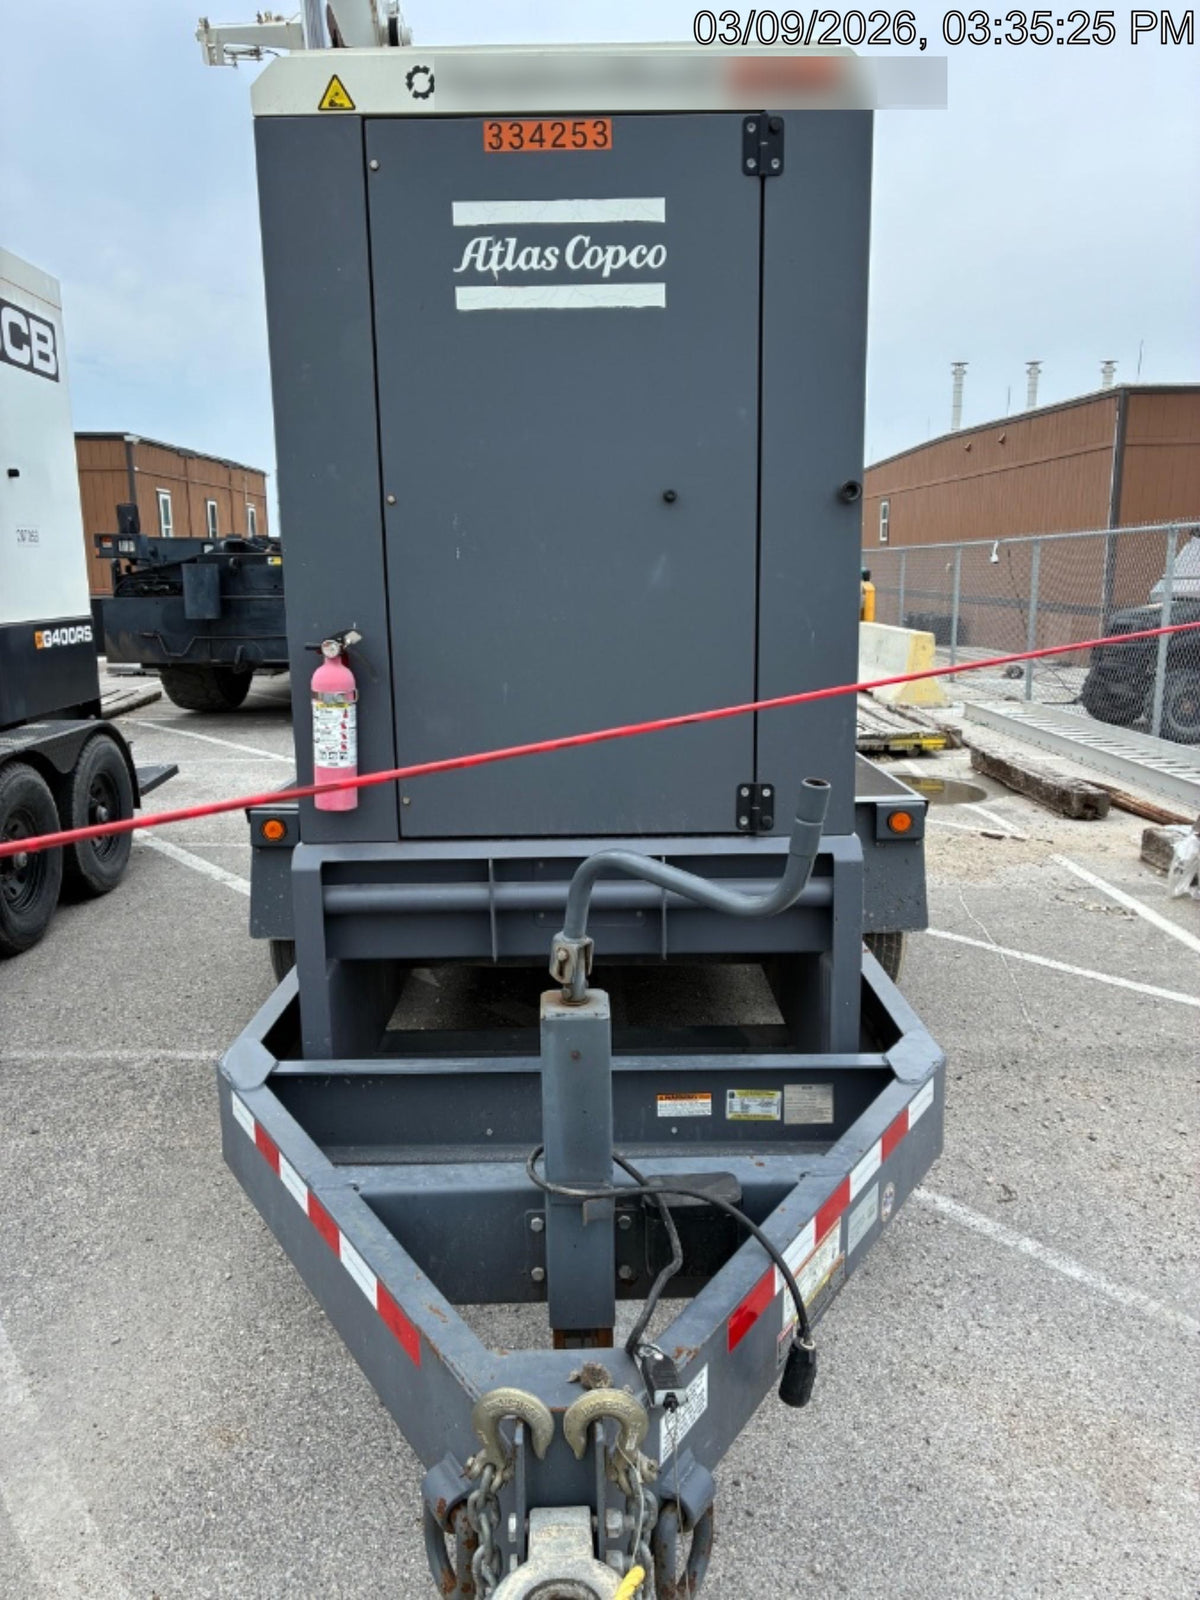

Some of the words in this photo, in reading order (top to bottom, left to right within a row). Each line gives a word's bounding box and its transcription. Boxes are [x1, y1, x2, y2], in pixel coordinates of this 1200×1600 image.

[488, 120, 608, 150] 334253
[453, 235, 560, 276] Atlas
[564, 234, 667, 278] Copco
[0, 306, 57, 375] CB
